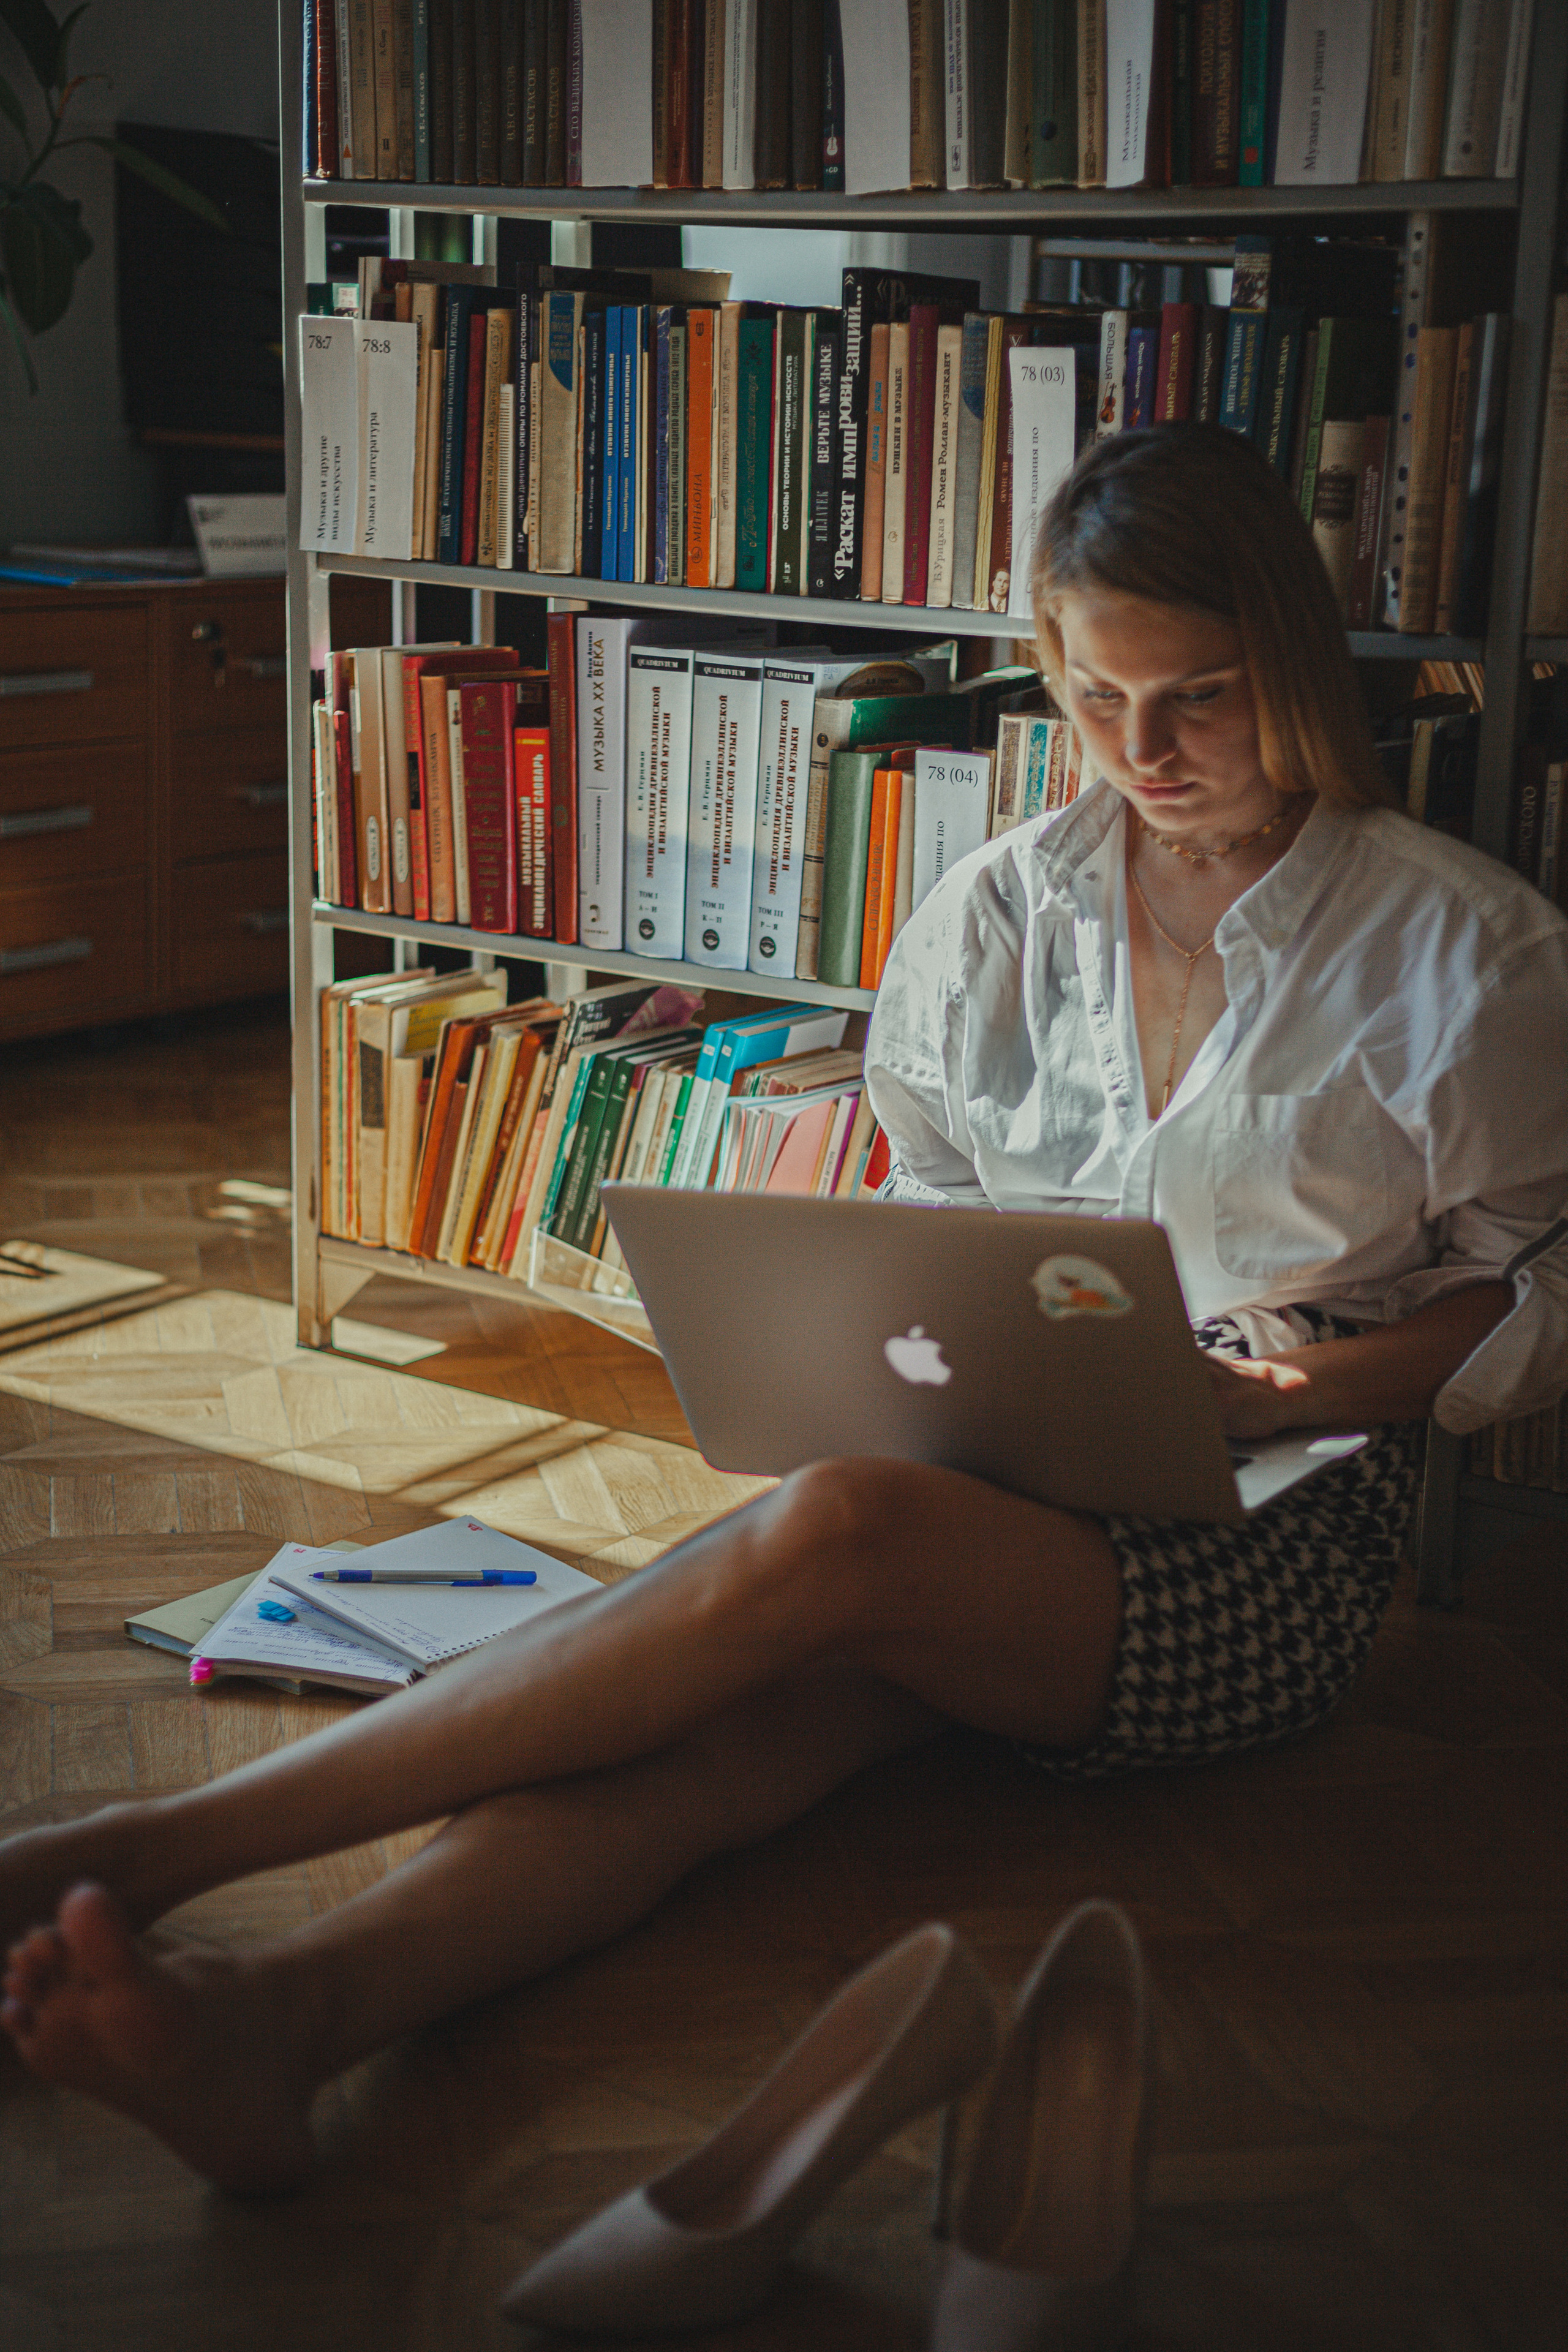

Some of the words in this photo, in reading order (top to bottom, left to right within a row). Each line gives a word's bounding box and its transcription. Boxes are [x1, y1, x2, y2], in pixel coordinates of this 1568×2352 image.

[1313, 29, 1326, 92] религия
[526, 68, 537, 145] В.В.СТАСОВ
[571, 59, 580, 112] ВЕЛИКИХ
[1215, 50, 1232, 156] МУЗЫКАЛЬНЫХ
[1311, 96, 1322, 105] и
[570, 115, 579, 139] СТО
[1121, 59, 1132, 161] Музыкальная
[1132, 73, 1141, 159] психология
[1303, 110, 1321, 172] Музыка
[308, 334, 332, 349] 78:7
[449, 303, 459, 339] МУЗЫКА
[519, 293, 529, 360] ДОСТОЕВСКОГО
[671, 336, 681, 352] ГОДА
[363, 338, 391, 353] 78:8
[671, 353, 680, 368] 1812
[1105, 322, 1116, 380] БОЛЬШАЯ
[1137, 342, 1145, 364] Юрий
[1168, 331, 1182, 381] СЛОВАРЬ
[1226, 322, 1243, 413] ЭНЦИКЛОПЕДИЯ
[1276, 334, 1291, 385] СЛОВАРЬ
[445, 349, 457, 405] РОМАНТИЗМА
[722, 375, 732, 415] МУЗЫКА
[785, 355, 793, 402] ИСКУССТВ
[818, 344, 832, 404] МУЗЫКЕ
[1021, 366, 1037, 381] 78
[1040, 366, 1065, 386] (03)
[1134, 366, 1143, 399] Бочаров
[519, 404, 527, 417] ПО
[671, 393, 680, 417] РОДНЫХ
[937, 352, 952, 465] Роллан-музыкант
[318, 435, 329, 478] другие
[369, 412, 380, 481] литература
[721, 428, 731, 486] ЛИТЕРАТУРА
[816, 410, 831, 464] ВЕРЬТЕ
[892, 426, 901, 475] ПУШКИН
[1031, 427, 1039, 445] по
[331, 445, 342, 506] искусства
[671, 451, 679, 479] СЛАВНЫХ
[936, 468, 948, 510] Ромен
[1001, 461, 1009, 473] НЕ
[670, 480, 679, 503] ПАМЯТЬ
[692, 473, 704, 543] МИНЬОНА
[316, 492, 329, 540] Музыка
[331, 510, 341, 540] виды
[363, 496, 377, 544] Музыка
[834, 490, 856, 581] «Раскат
[593, 638, 604, 676] ВЕКА
[637, 658, 679, 668] QUADRIVIUM
[703, 666, 746, 677] QUADRIVIUM
[766, 669, 809, 681] QUADRIVIUM
[593, 681, 604, 701] XX
[594, 706, 605, 772] МУЗЫКА
[649, 686, 661, 790] ДРЕВНЕЭЛЛИНСКОЙ
[662, 712, 671, 758] МУЗЫКИ
[715, 695, 728, 801] ДРЕВНЕЭЛЛИНСКОЙ
[728, 722, 738, 767] МУЗЫКИ
[774, 699, 790, 806] ДРЕВНЕЭЛЛИНСКОЙ
[428, 732, 440, 801] МУЗЫКАНТА
[531, 753, 545, 804] СЛОВАРЬ
[763, 765, 772, 804] Герцман
[928, 766, 945, 780] 78
[949, 767, 978, 788] (04)
[658, 761, 669, 844] ВИЗАНТИЙСКОЙ
[703, 802, 709, 810] В.
[723, 771, 735, 854] ВИЗАНТИЙСКОЙ
[763, 807, 769, 815] В.
[782, 776, 796, 861] ВИЗАНТИЙСКОЙ
[790, 727, 799, 773] МУЗЫКИ
[432, 807, 442, 863] СПУТНИК
[519, 796, 532, 886] МУЗЫКАЛЬНЫЙ
[646, 793, 657, 879] ЭНЦИКЛОПЕДИЯ
[711, 802, 722, 889] ЭНЦИКЛОПЕДИЯ
[769, 808, 782, 895] ЭНЦИКЛОПЕДИЯ
[937, 820, 944, 837] по
[531, 807, 546, 929] ЭНЦИКЛОПЕДИЧЕСКИЙ
[935, 840, 944, 883] здания
[639, 891, 653, 899] ТОМ
[701, 900, 716, 910] ТОМ
[867, 843, 883, 931] СПРАВОЧНИК
[758, 907, 772, 916] ТОМ
[774, 909, 784, 918] III
